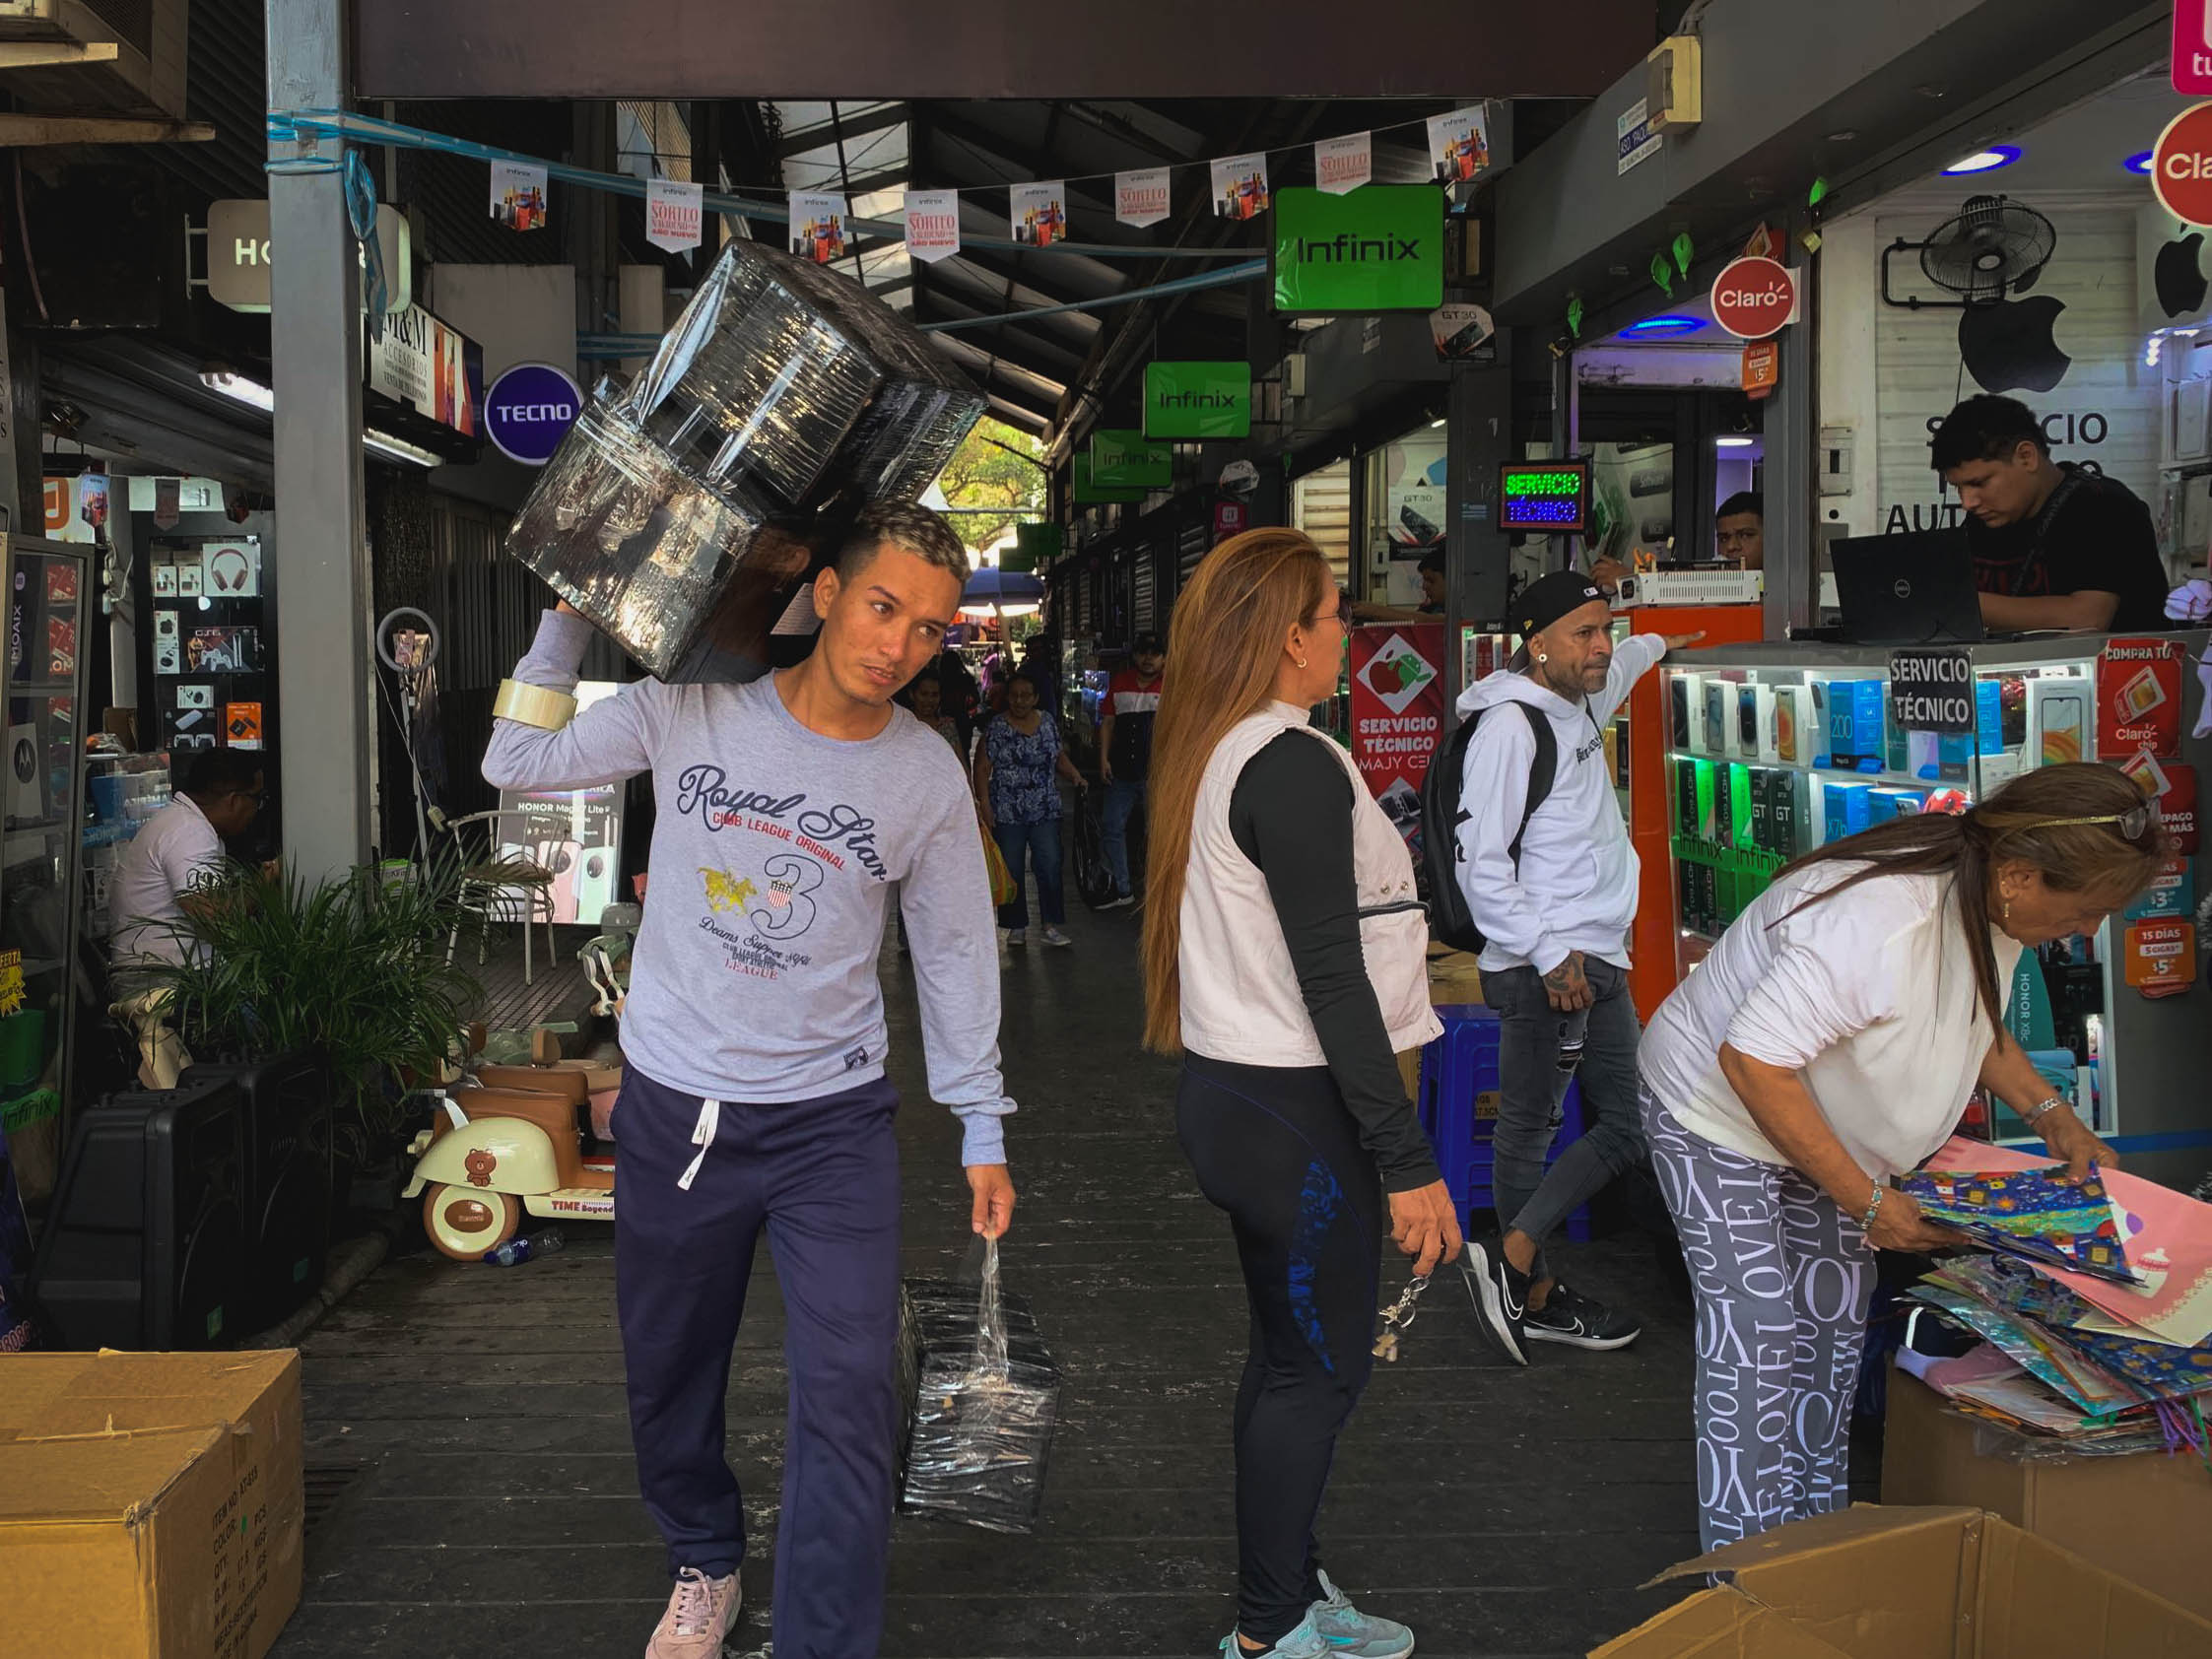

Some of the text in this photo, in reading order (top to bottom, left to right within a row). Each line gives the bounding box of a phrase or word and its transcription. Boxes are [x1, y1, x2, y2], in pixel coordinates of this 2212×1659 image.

[2166, 152, 2212, 180] Cla
[1298, 232, 1421, 264] Infinix
[1720, 285, 1781, 307] Claro
[1160, 389, 1236, 409] Infinix
[498, 403, 572, 423] TECNO
[1506, 473, 1580, 496] SERVICIO
[2105, 646, 2154, 661] COMPRA
[1891, 656, 1969, 683] SERVICIO
[1894, 692, 1970, 723] TÉCNICO
[1359, 716, 1438, 734] SERVICIO
[1831, 714, 1853, 740] 200
[2115, 727, 2154, 741] Claro
[2137, 739, 2158, 751] chip
[1359, 756, 1403, 770] MAJY
[517, 802, 554, 813] HONOR
[1752, 803, 1767, 819] GT
[1776, 806, 1791, 822] GT
[677, 763, 888, 882] Royal Star
[747, 817, 794, 841] LEAGUE
[794, 833, 847, 872] ORIGINAL
[1678, 830, 1724, 862] Infinix
[750, 853, 825, 941] 3
[2142, 927, 2181, 941] 15 DÍAS
[2020, 973, 2031, 1019] HONOR
[551, 1200, 580, 1212] TIME
